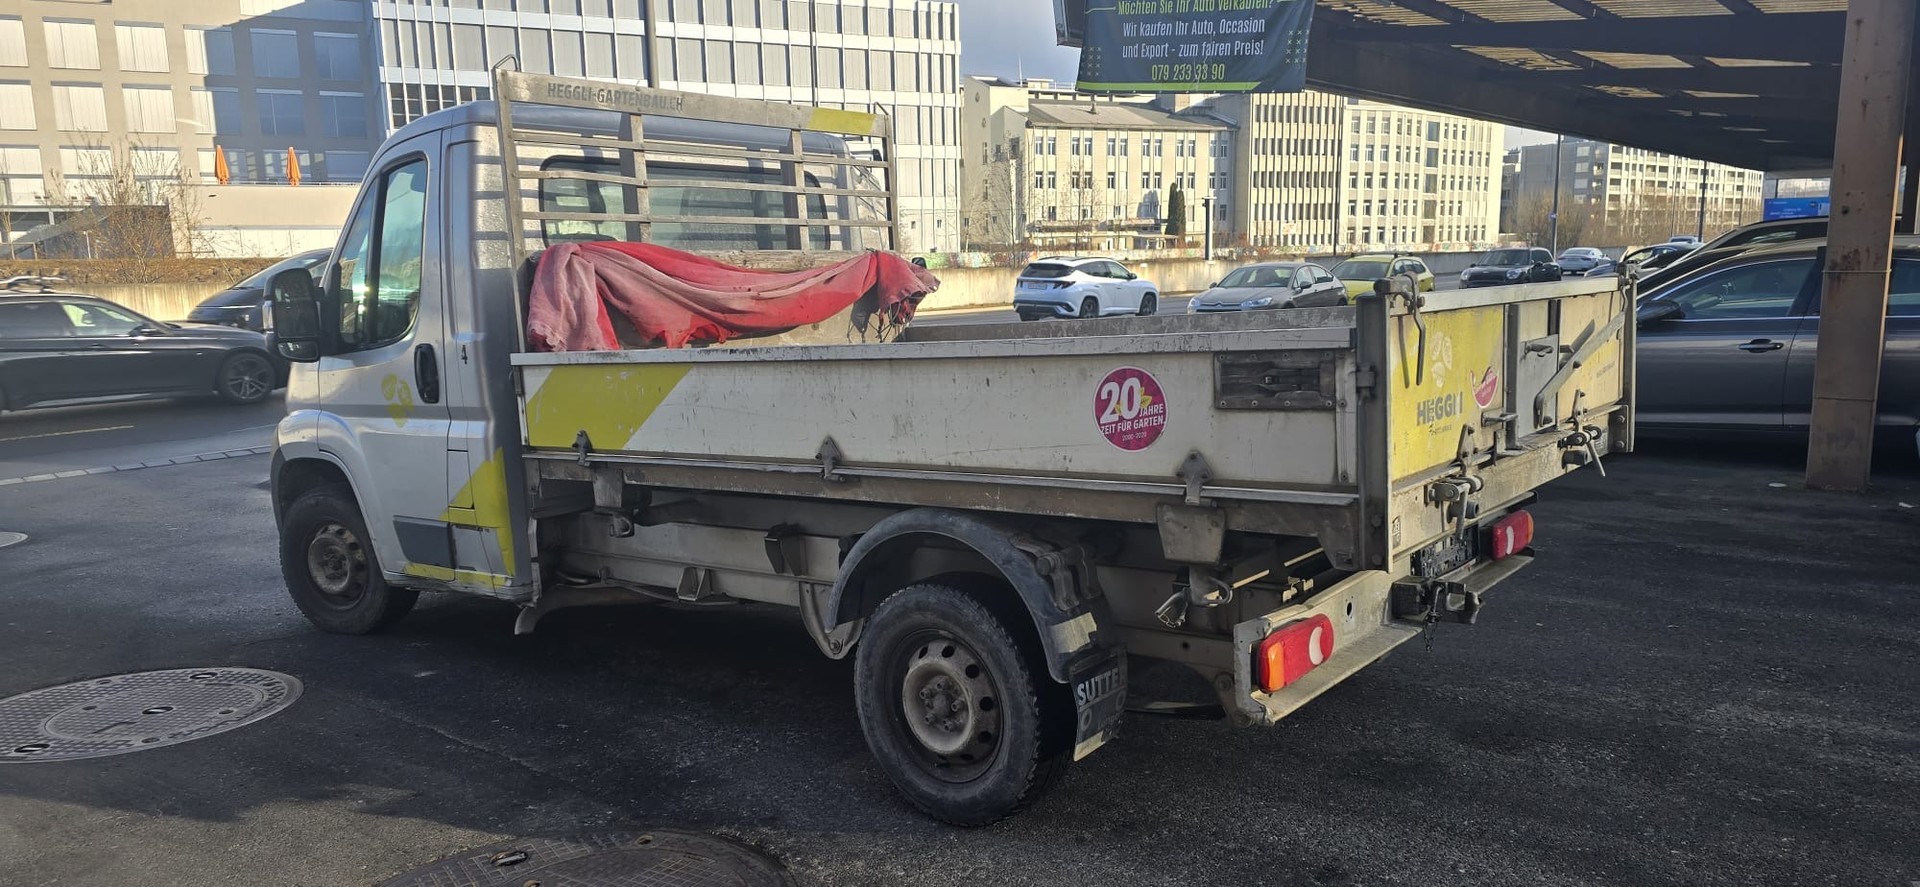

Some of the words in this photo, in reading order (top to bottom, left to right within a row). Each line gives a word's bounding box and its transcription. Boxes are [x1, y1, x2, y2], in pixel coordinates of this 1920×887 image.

[1118, 0, 1157, 15] Möchten
[1159, 0, 1173, 14] Sie
[1176, 0, 1190, 13] Ihr
[1192, 0, 1215, 12] Auto
[1123, 22, 1138, 37] Wir
[1140, 21, 1172, 36] kaufen
[1175, 20, 1189, 36] Ihr
[1191, 20, 1216, 36] Auto,
[1219, 17, 1265, 34] Occasion
[1122, 43, 1139, 58] und
[1141, 42, 1169, 59] Export
[1178, 43, 1199, 57] zum
[1201, 41, 1231, 56] fairen
[1234, 39, 1265, 56] Preis!
[1151, 64, 1169, 81] 079
[1173, 63, 1192, 80] 233
[1212, 63, 1225, 80] 90
[1100, 377, 1141, 424] 20
[1139, 403, 1164, 417] JAHRE
[1100, 423, 1116, 435] ZEIT
[1117, 420, 1132, 433] FÜR
